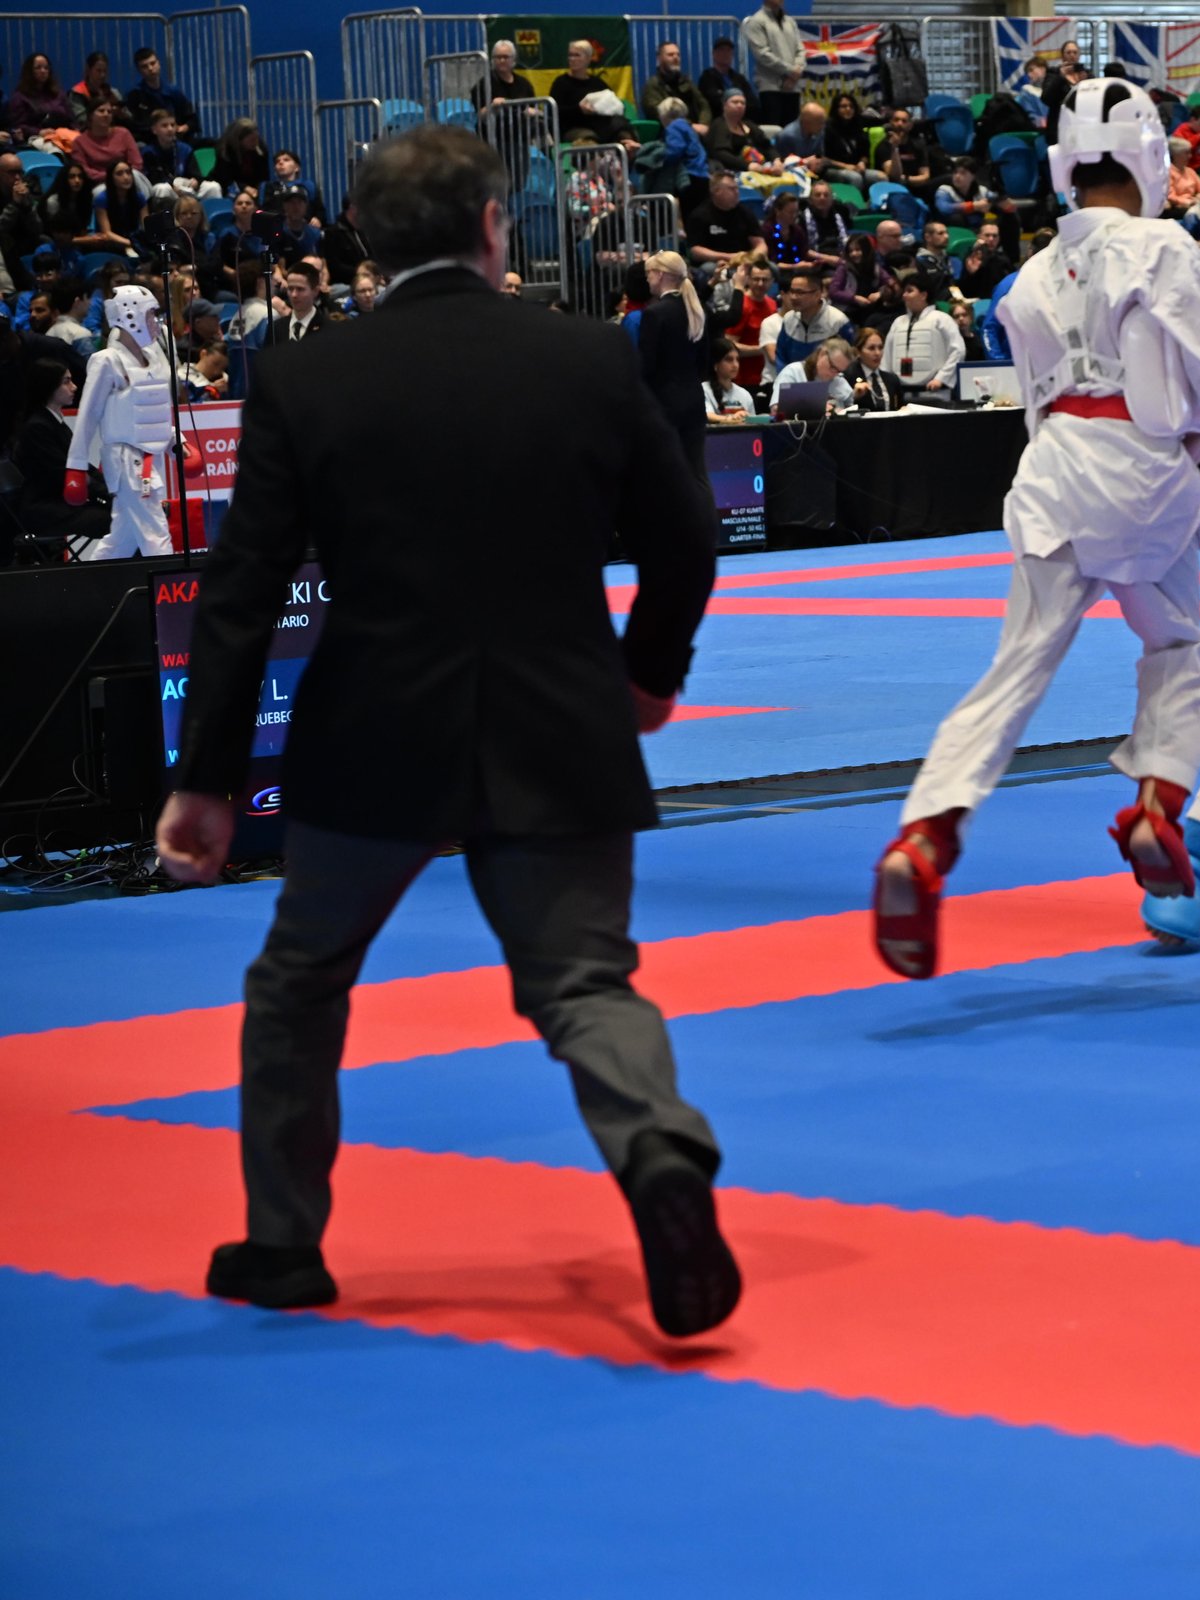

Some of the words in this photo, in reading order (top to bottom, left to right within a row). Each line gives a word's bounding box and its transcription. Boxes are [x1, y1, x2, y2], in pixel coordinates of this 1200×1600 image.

[205, 438, 240, 453] COA
[753, 439, 762, 457] 0
[202, 458, 240, 476] RAÎN
[754, 475, 764, 493] 0
[156, 580, 199, 604] AKA
[272, 679, 288, 700] L.
